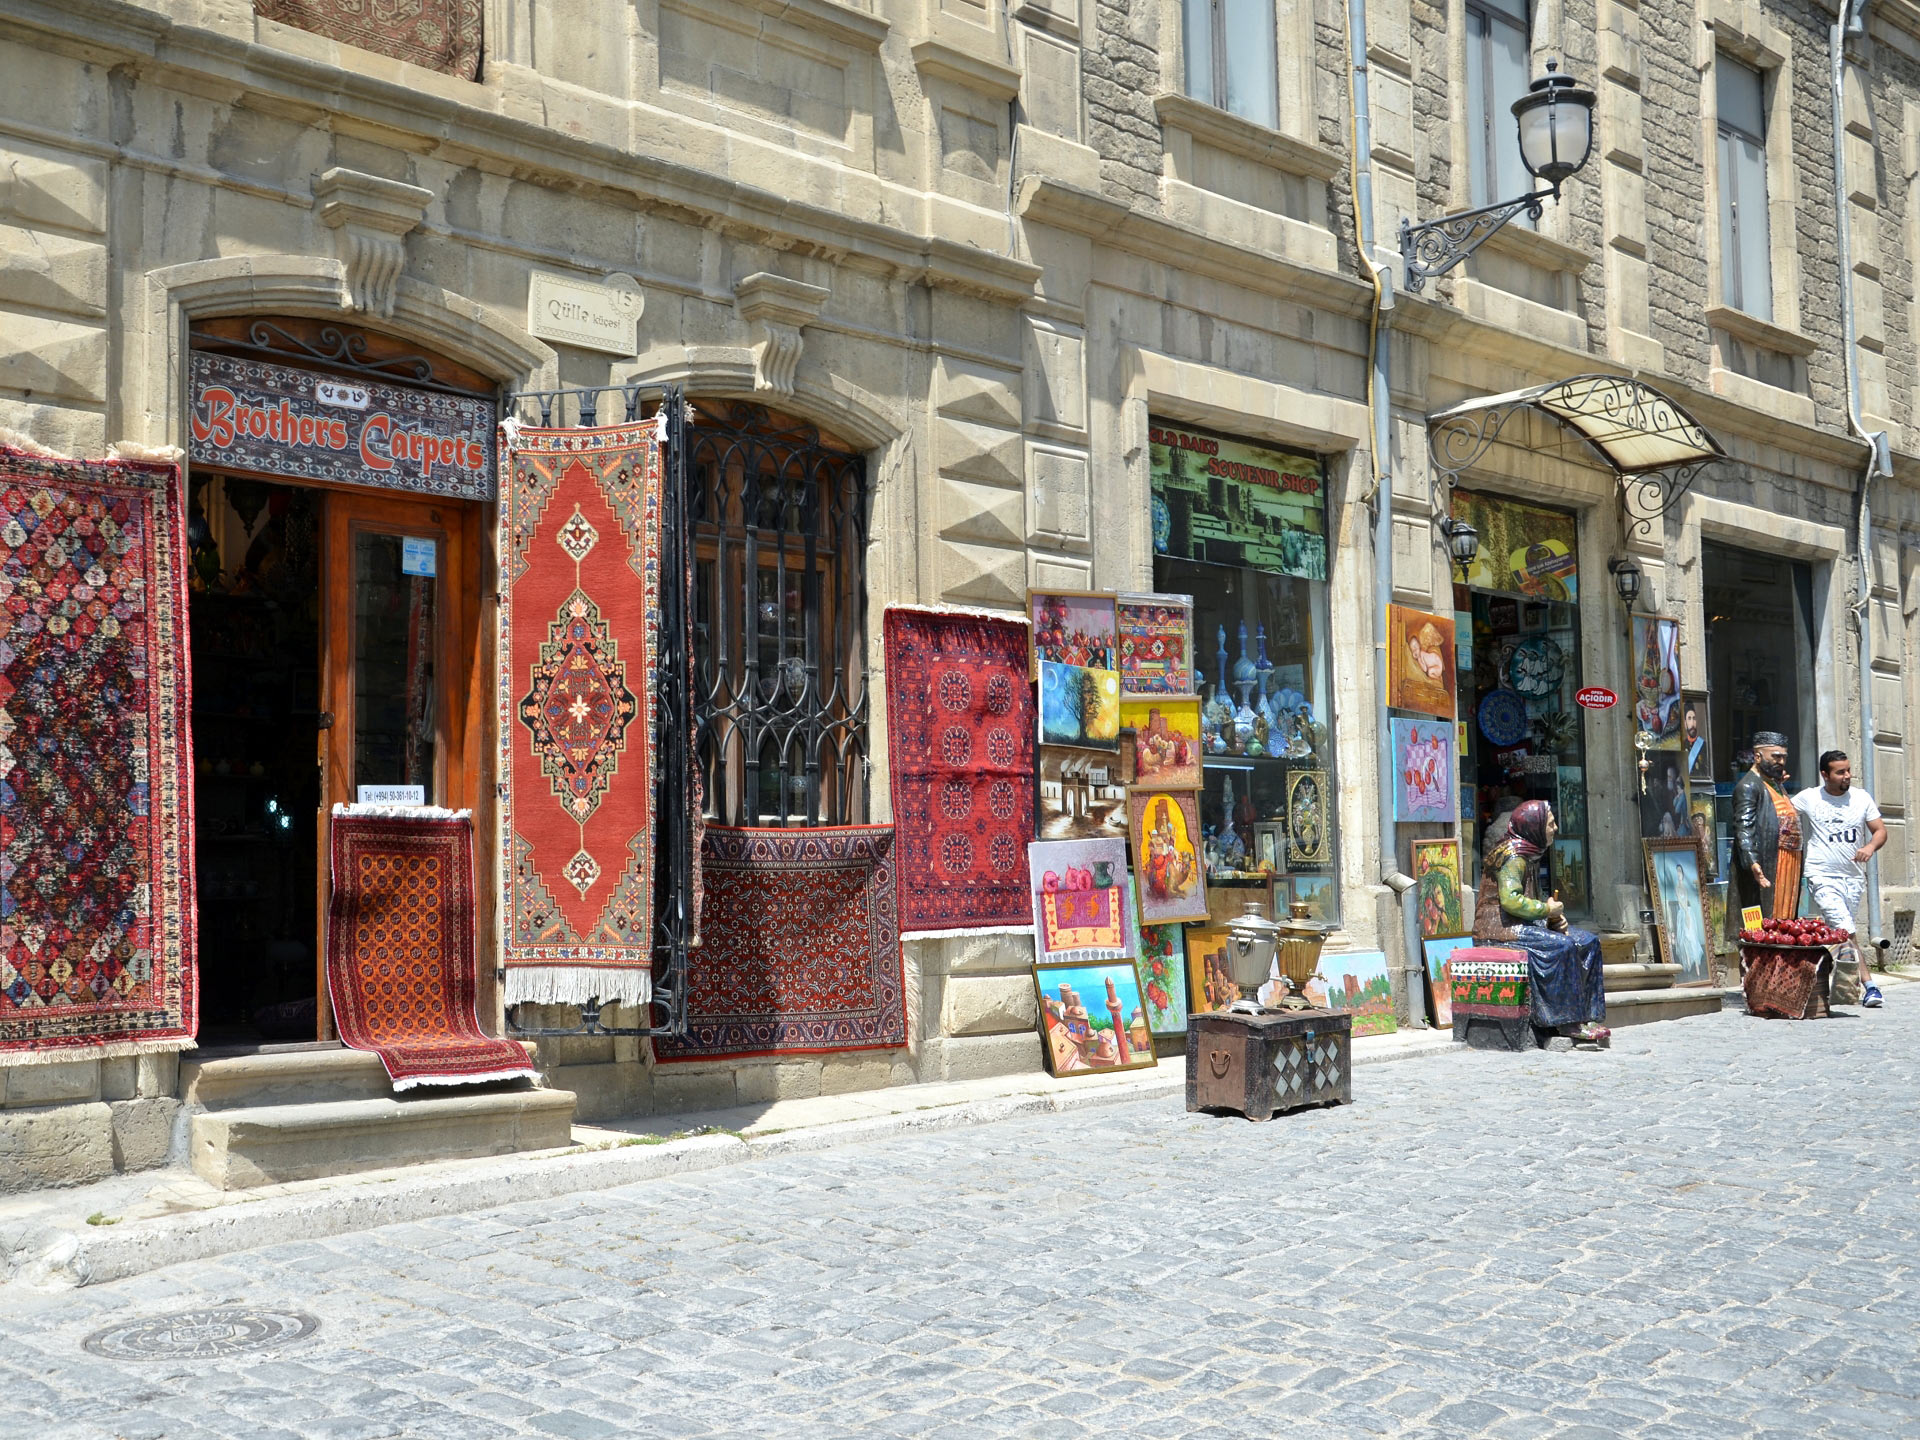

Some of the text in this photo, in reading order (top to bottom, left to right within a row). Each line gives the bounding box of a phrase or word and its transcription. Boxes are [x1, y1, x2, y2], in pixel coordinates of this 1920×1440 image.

[616, 290, 633, 307] 15
[548, 299, 621, 329] Qüllə küçəsi
[191, 384, 485, 477] Brothers Carpets
[1149, 428, 1219, 456] OLD BAKU
[1208, 457, 1319, 495] SOUVENIR SHOP
[1579, 693, 1613, 704] AÇIQDIR
[374, 791, 389, 803] (+994)
[389, 790, 419, 802] 50-361-10-12
[1744, 910, 1761, 923] FOTO
